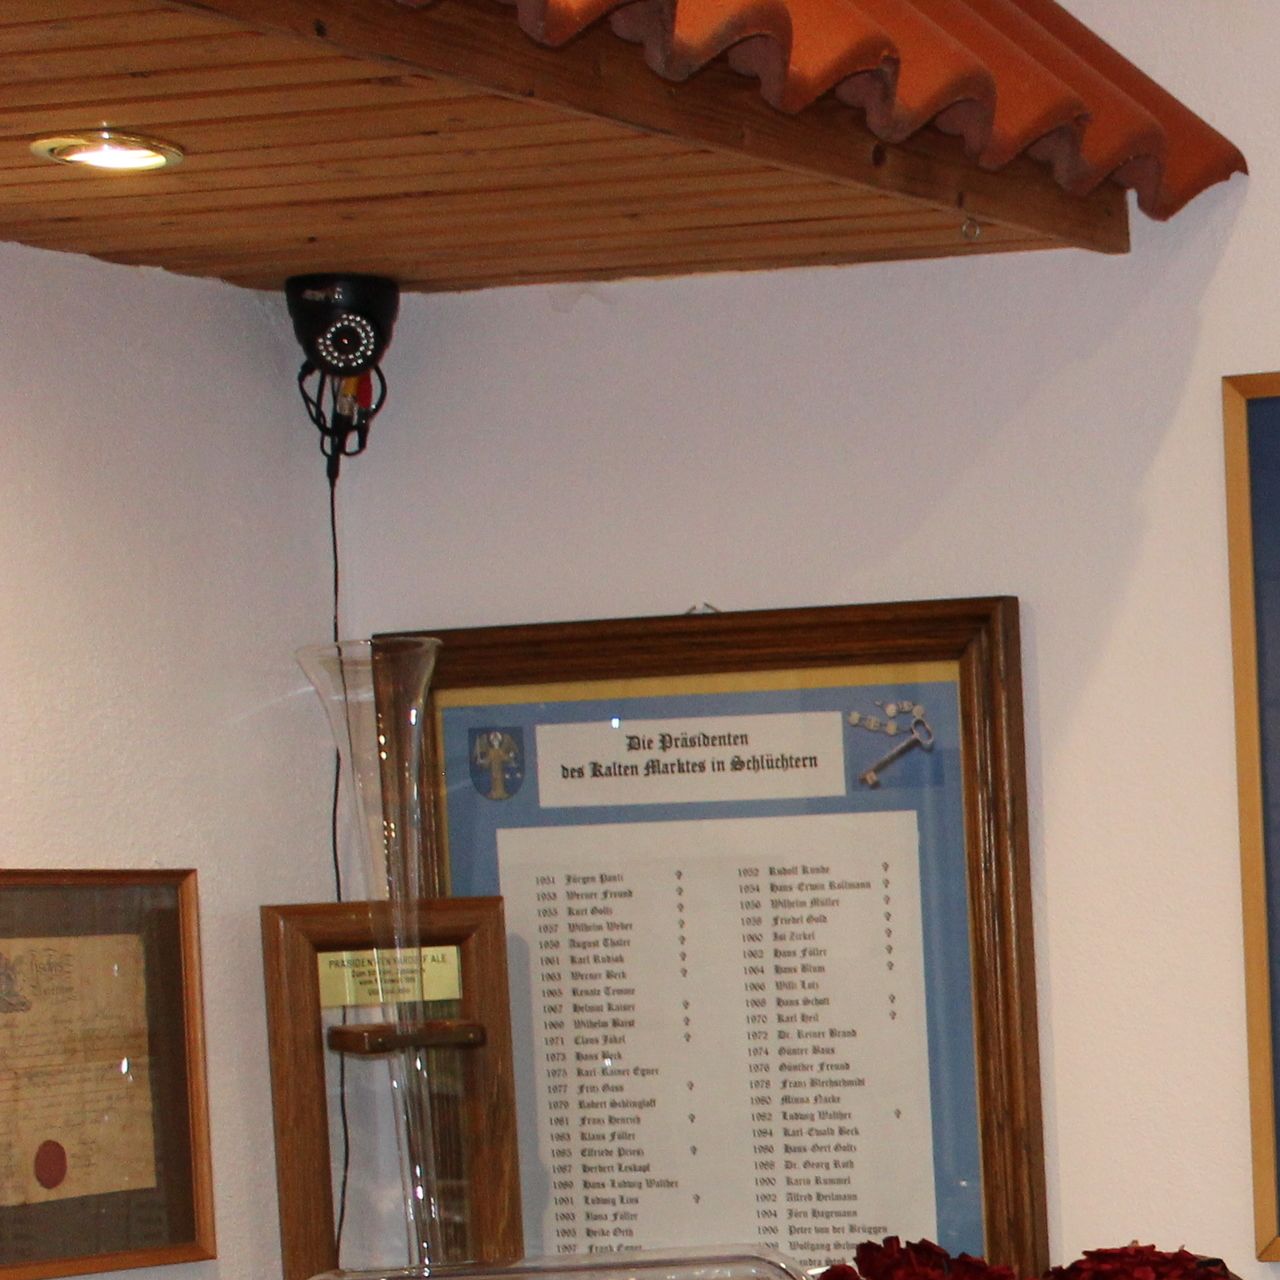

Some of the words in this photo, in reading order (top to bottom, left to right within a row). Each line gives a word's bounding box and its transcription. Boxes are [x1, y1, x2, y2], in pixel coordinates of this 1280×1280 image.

[625, 734, 654, 751] Die
[659, 730, 749, 750] Präsidenten
[560, 762, 584, 779] des
[588, 759, 638, 777] Kalten
[643, 756, 706, 775] Marktes
[711, 755, 725, 772] in
[730, 751, 818, 770] Schlüchtern
